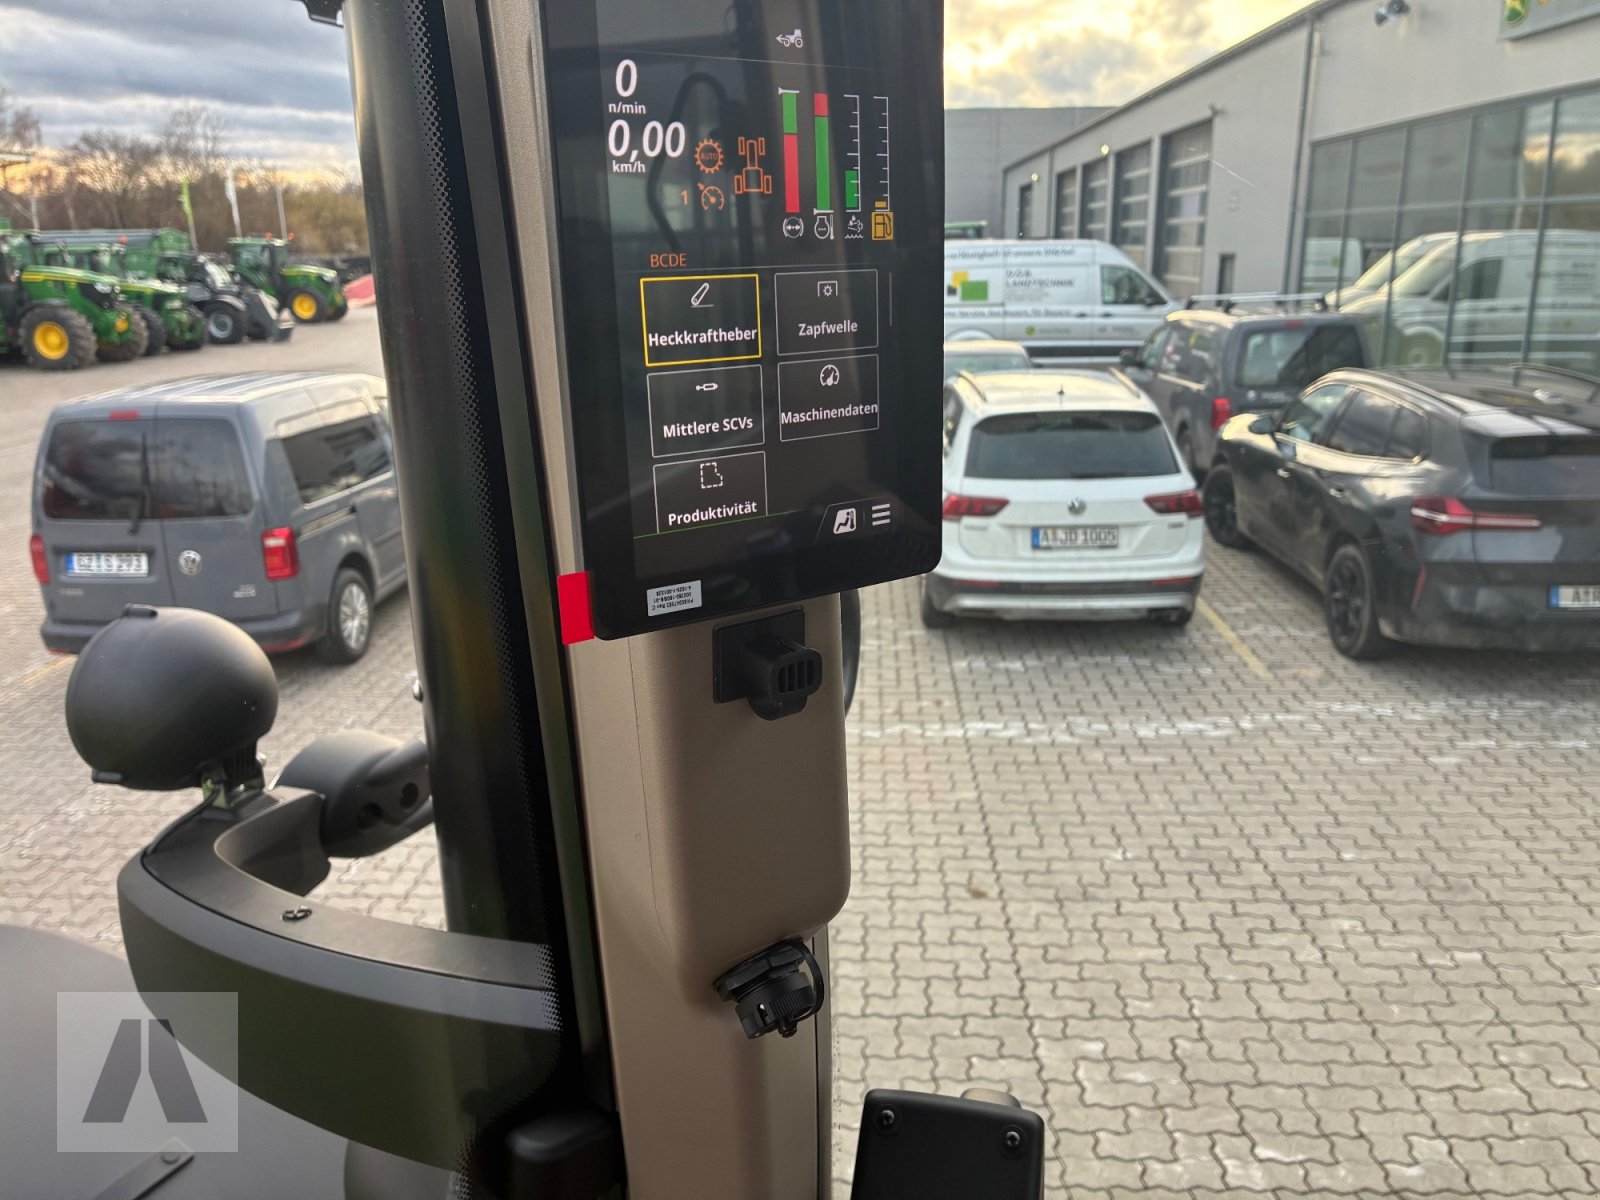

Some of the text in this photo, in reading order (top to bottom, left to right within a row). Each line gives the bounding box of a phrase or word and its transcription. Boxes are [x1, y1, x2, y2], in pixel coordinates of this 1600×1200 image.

[615, 59, 638, 97] 0
[608, 101, 647, 115] n/min
[608, 119, 686, 163] 0,00
[612, 160, 646, 174] km/h
[680, 190, 689, 205] 1
[650, 253, 687, 267] BCDE
[648, 328, 758, 347] Heckkraftheber
[798, 320, 858, 337] Zapfwelle
[781, 402, 878, 425] Maschinendaten
[663, 416, 754, 438] Mittlere SCVs
[668, 501, 758, 526] Produktivität
